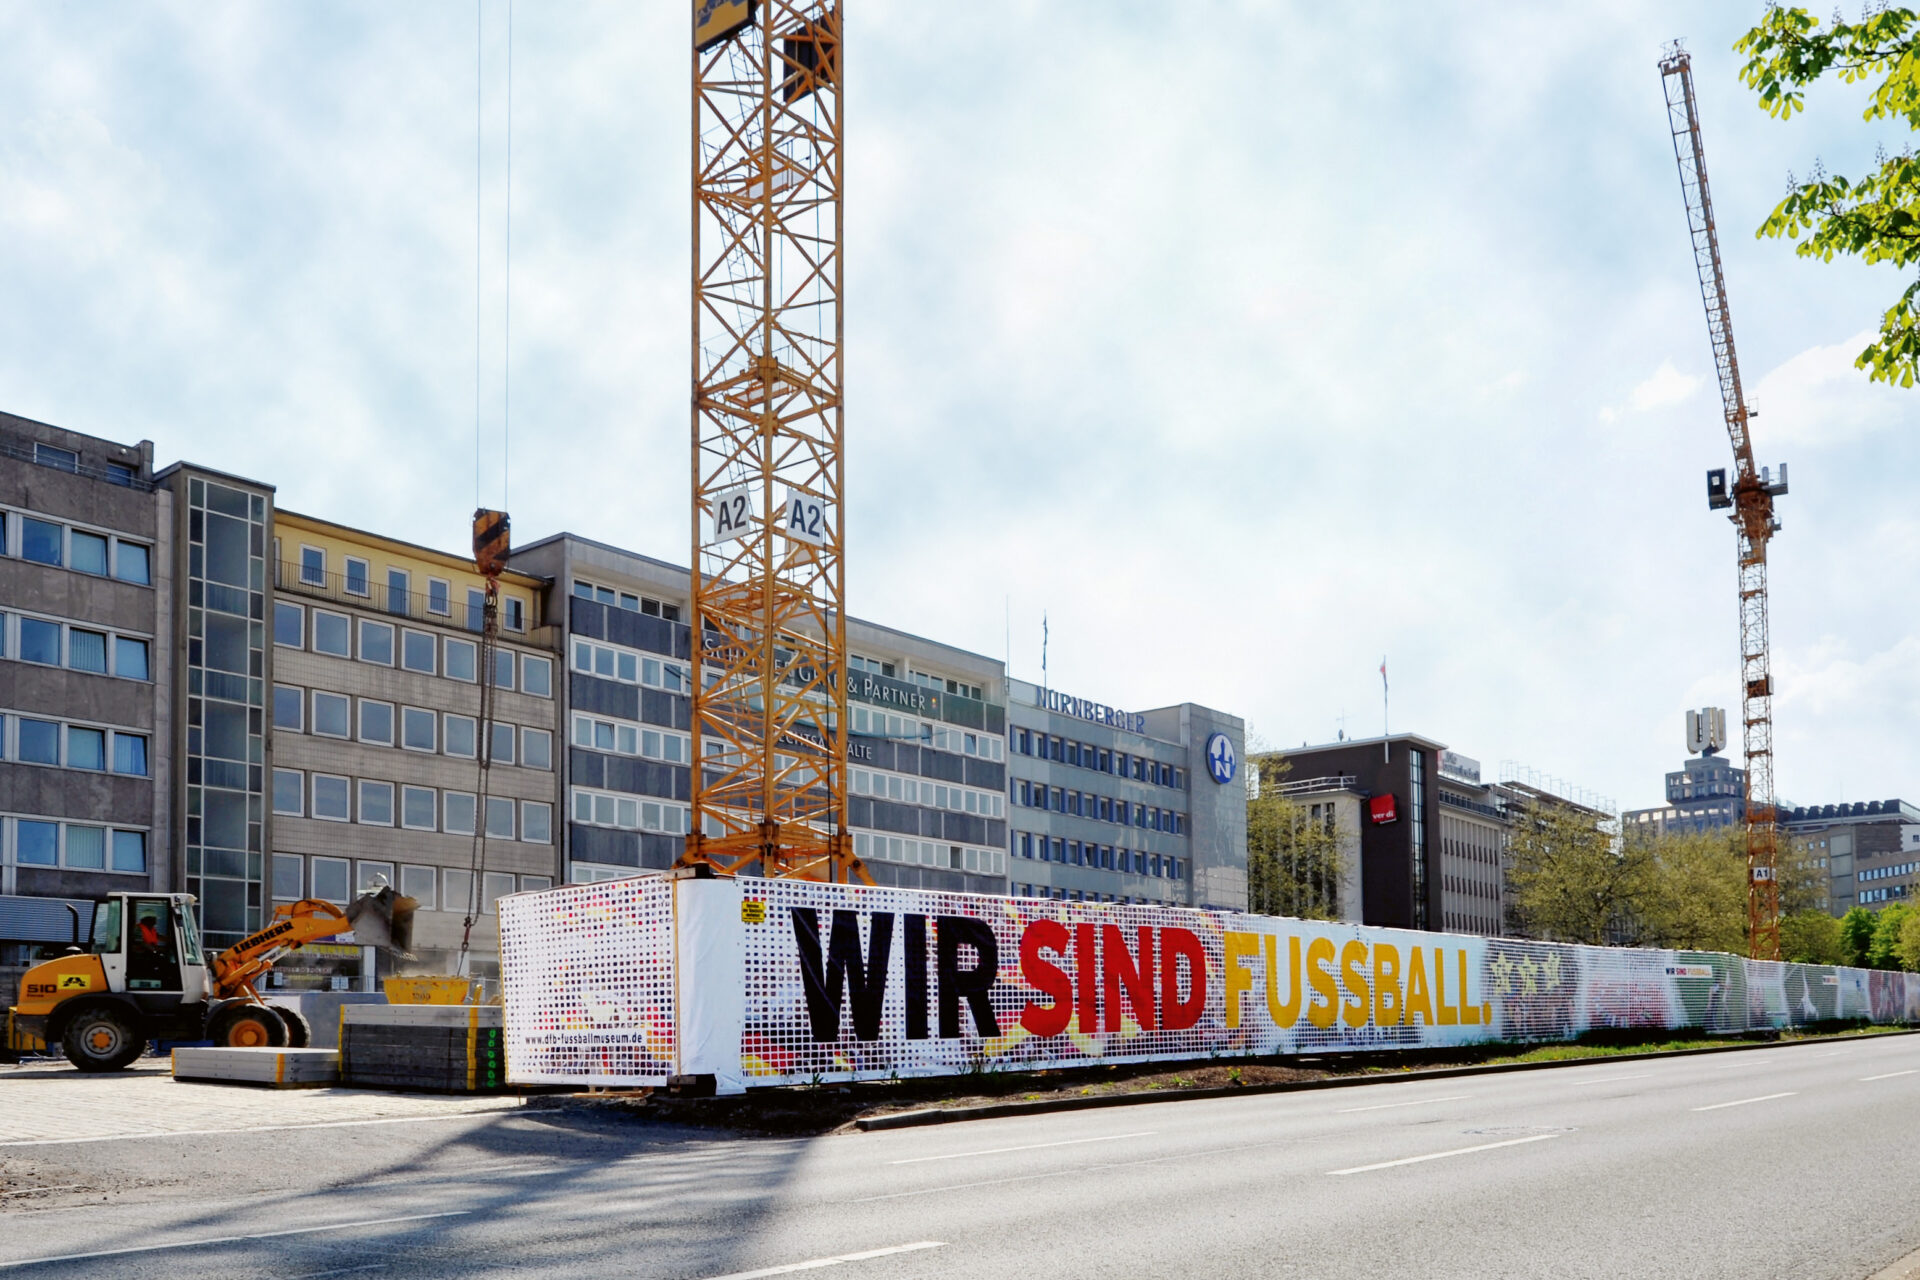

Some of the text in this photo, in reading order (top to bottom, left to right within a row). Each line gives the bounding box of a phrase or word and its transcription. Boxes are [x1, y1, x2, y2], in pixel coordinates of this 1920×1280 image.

[717, 495, 747, 535] A2
[789, 498, 821, 538] A2
[847, 677, 858, 694] &
[864, 679, 926, 710] PARTNER
[1215, 760, 1231, 779] N
[1756, 869, 1768, 879] A1
[233, 921, 294, 954] LIEBHERR
[790, 906, 1493, 1043] WIR SIND FUSSBALL.
[525, 1033, 643, 1045] www.dfb-fussballmuseum.de
